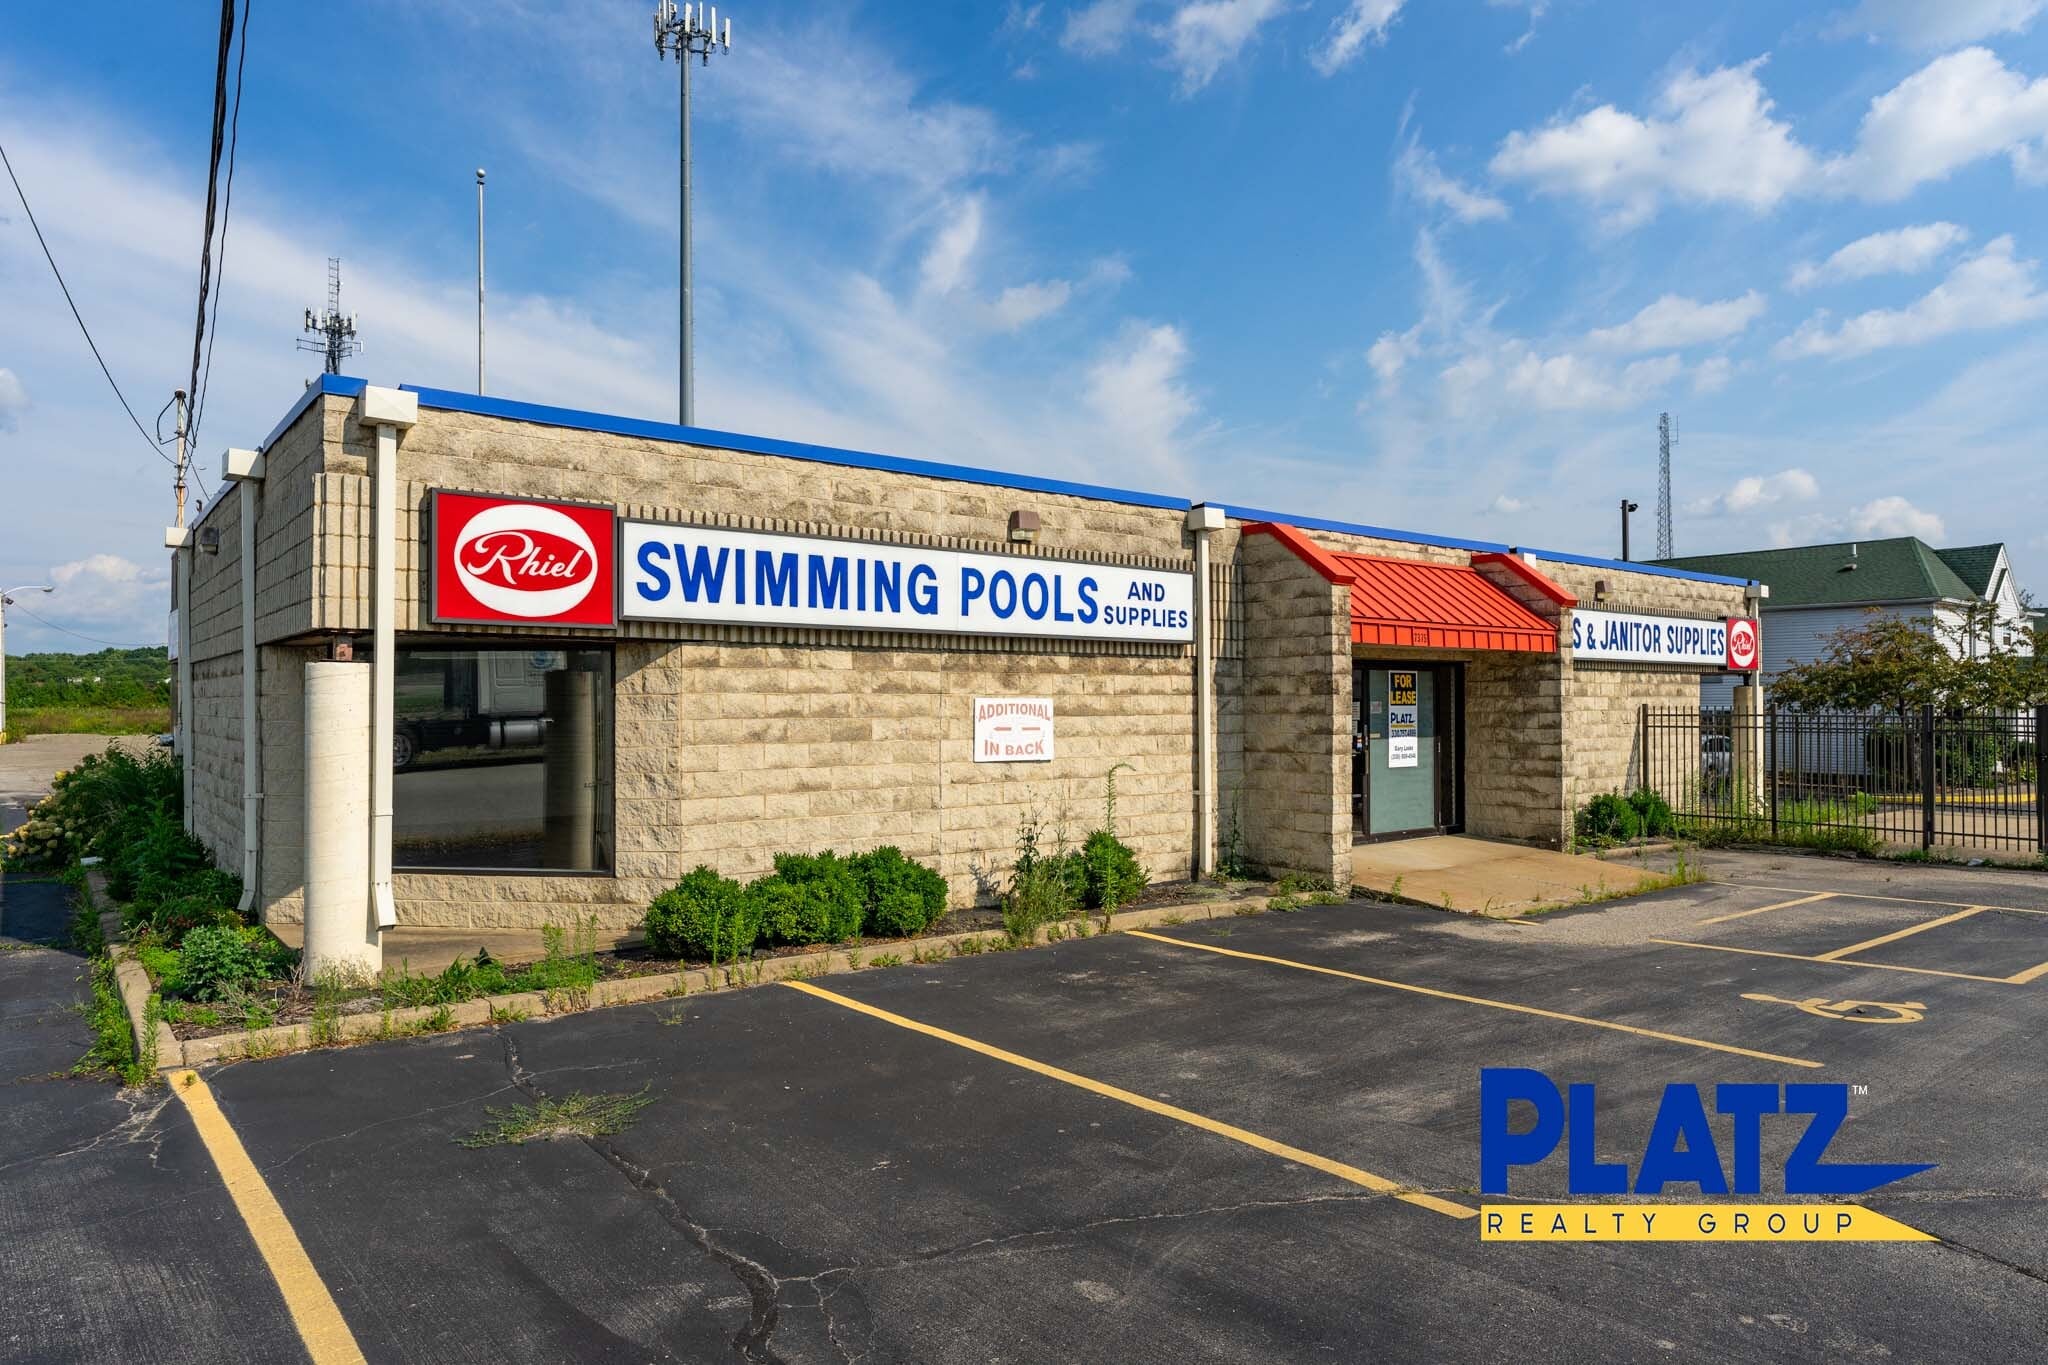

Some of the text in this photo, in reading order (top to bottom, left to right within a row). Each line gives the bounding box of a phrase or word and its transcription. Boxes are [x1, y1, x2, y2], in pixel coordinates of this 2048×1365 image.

[467, 531, 584, 585] Rhiel
[636, 541, 1098, 624] SWIMMING POOLS
[1128, 581, 1165, 602] AND
[1104, 606, 1188, 629] SUPPLIES
[1587, 623, 1597, 650] &
[1600, 620, 1661, 653] JANITOR
[1667, 625, 1725, 656] SUPPLIES
[1394, 674, 1412, 688] FOR
[1390, 690, 1416, 704] LEASE
[978, 703, 1051, 721] ADDITIONAL
[1390, 712, 1415, 724] PLATZ
[984, 739, 1044, 756] IN BACK
